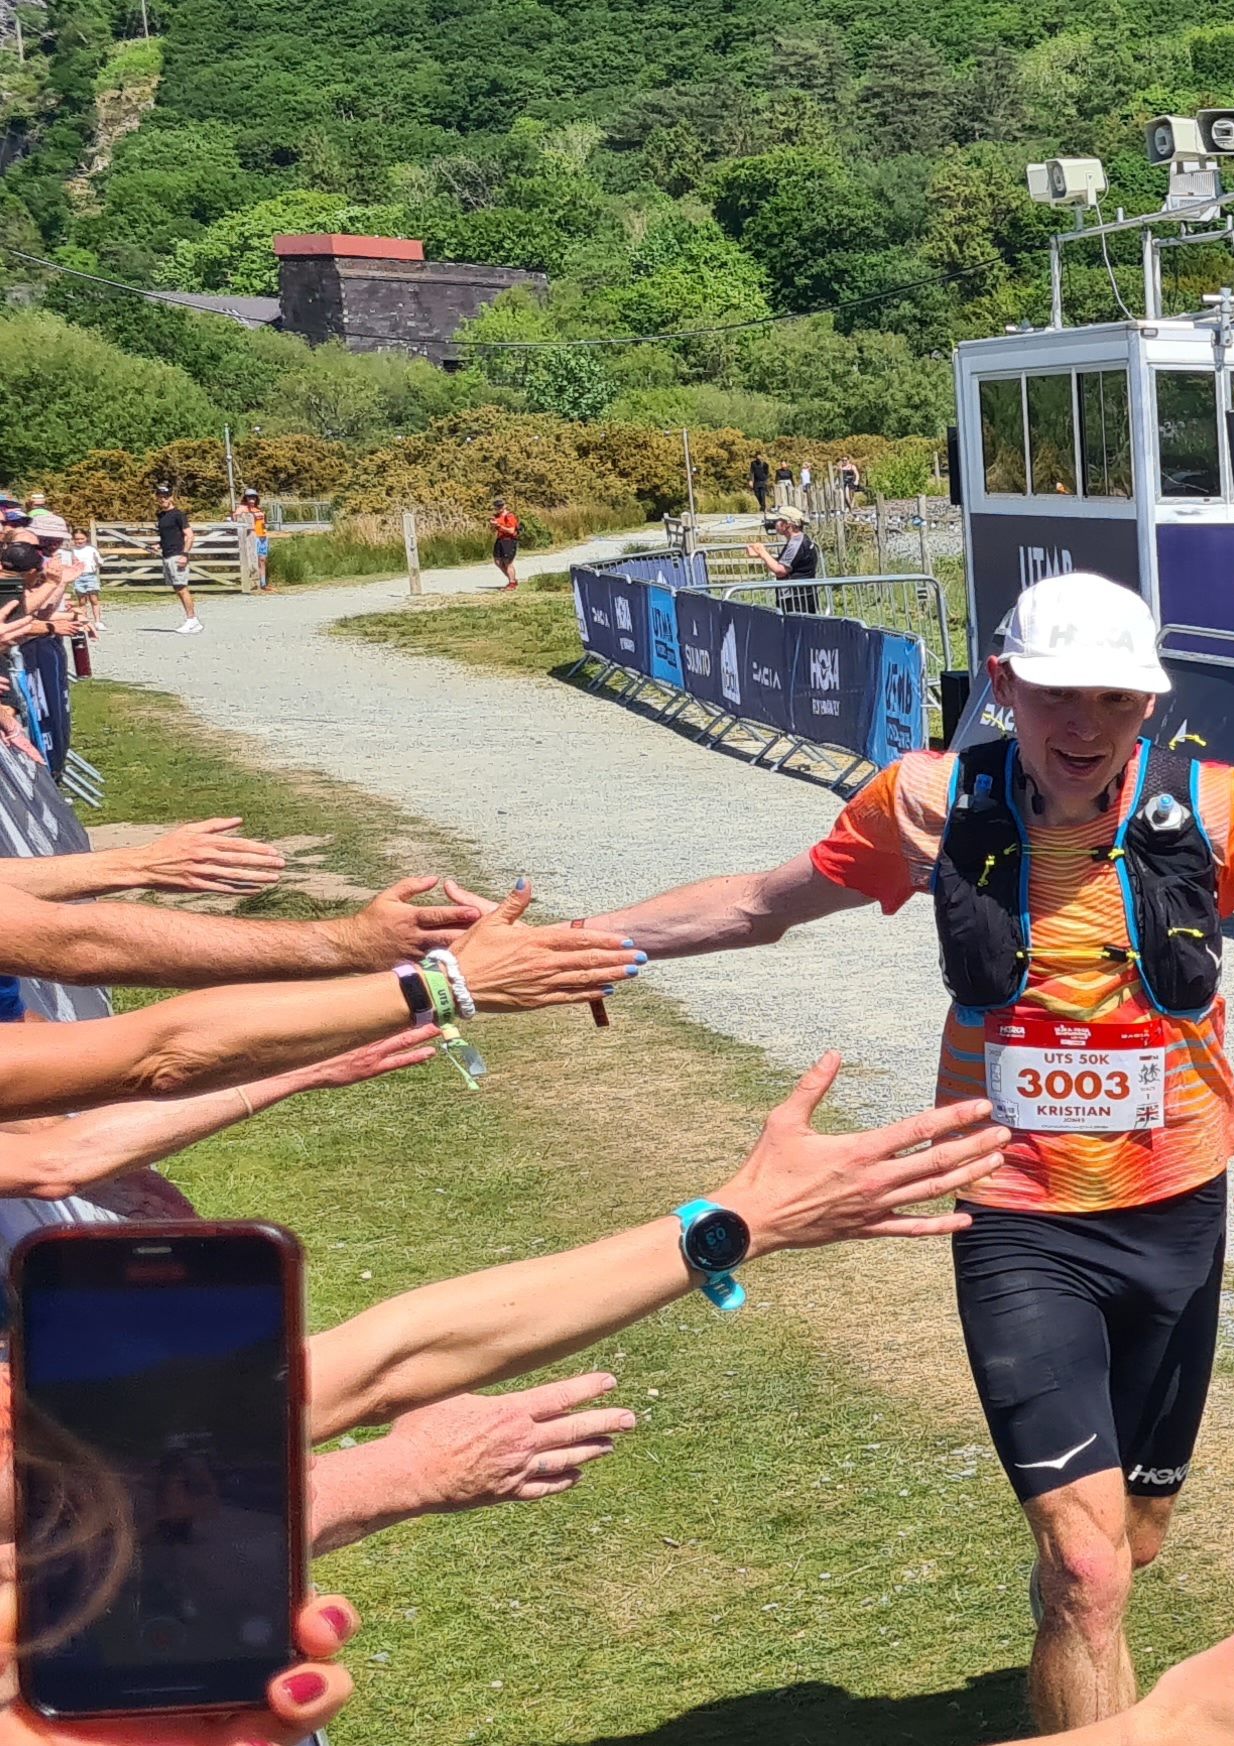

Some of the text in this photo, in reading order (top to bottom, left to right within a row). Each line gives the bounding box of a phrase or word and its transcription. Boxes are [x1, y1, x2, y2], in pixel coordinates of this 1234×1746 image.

[1049, 623, 1135, 653] HA
[684, 643, 711, 678] SUUNTO
[752, 661, 782, 690] DACIA
[810, 648, 840, 691] HOKA
[979, 703, 1017, 733] DAC
[1044, 1053, 1110, 1065] UTS 50K
[1016, 1068, 1131, 1101] 3003
[1037, 1105, 1112, 1117] KRISTIAN
